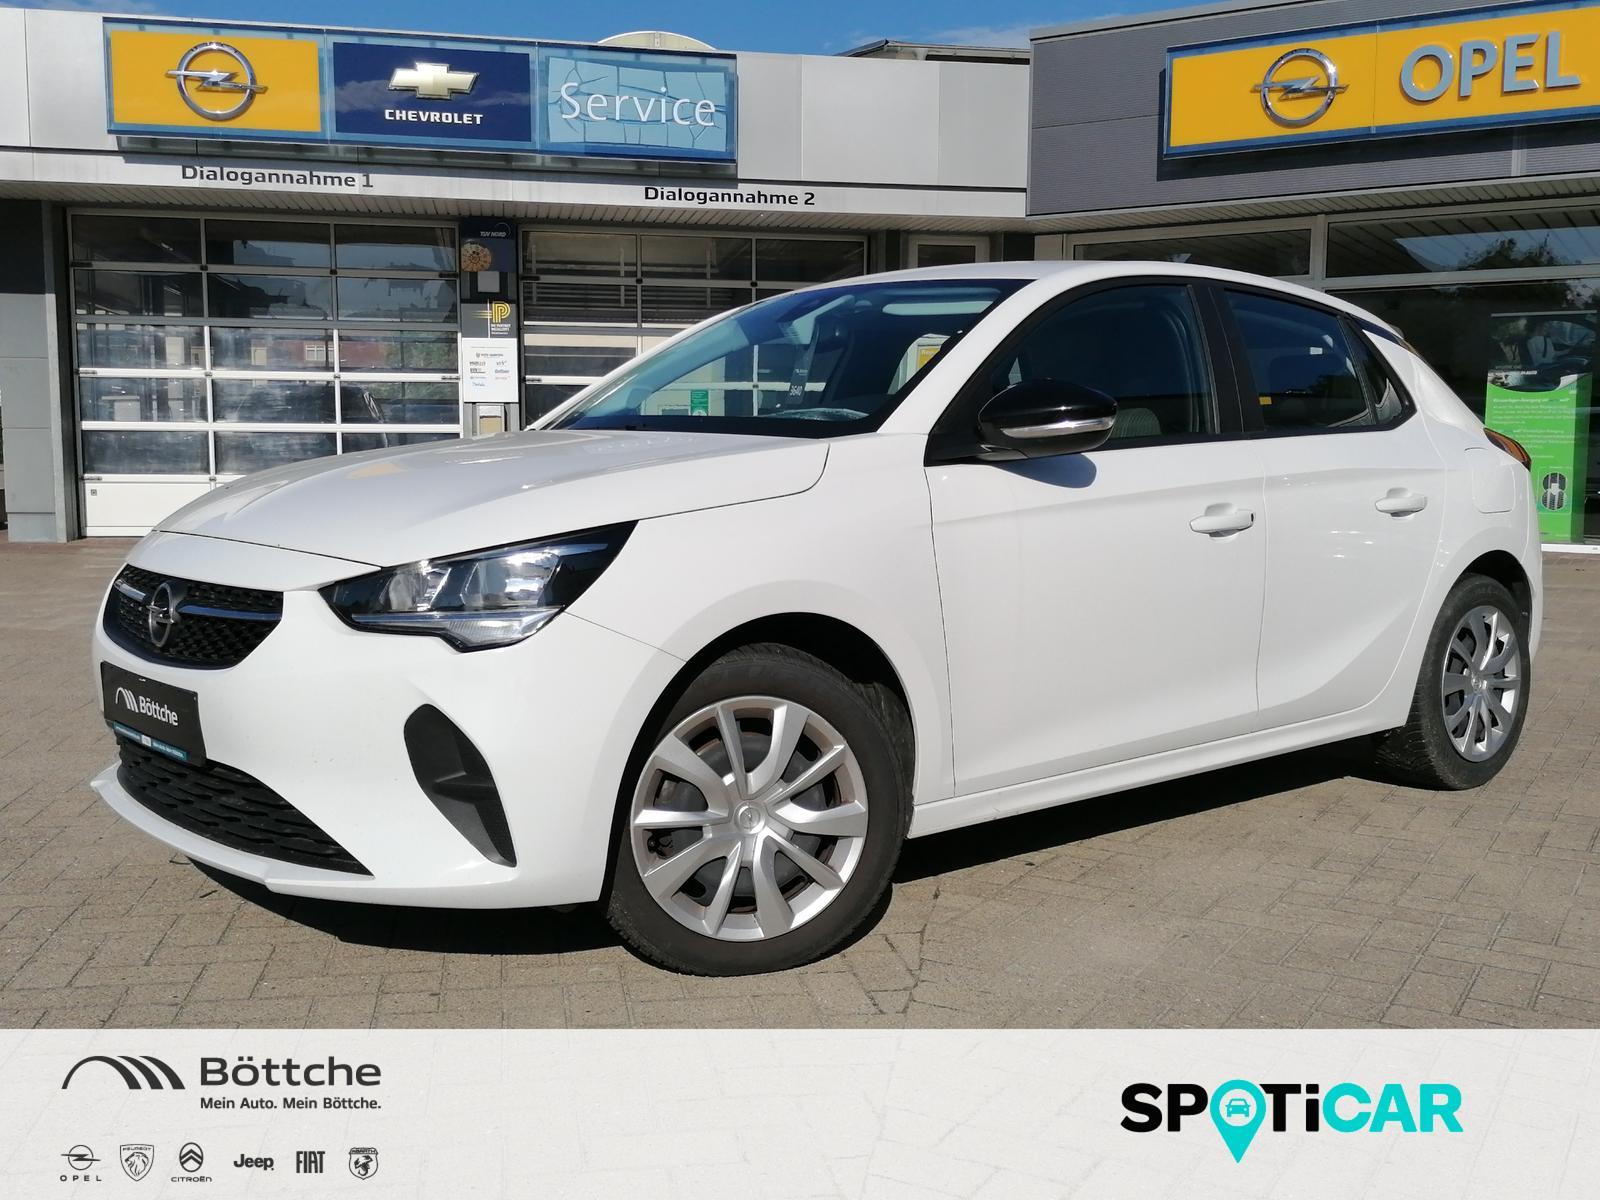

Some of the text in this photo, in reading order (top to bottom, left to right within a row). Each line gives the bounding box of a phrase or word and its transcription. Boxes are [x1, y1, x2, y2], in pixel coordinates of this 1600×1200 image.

[1400, 31, 1581, 101] OPEL
[384, 109, 484, 125] CHEVROLET
[560, 82, 716, 126] Service
[181, 165, 374, 188] Dialogannahme 1
[644, 187, 815, 205] Dialogannahme 2
[139, 695, 178, 726] Böttche
